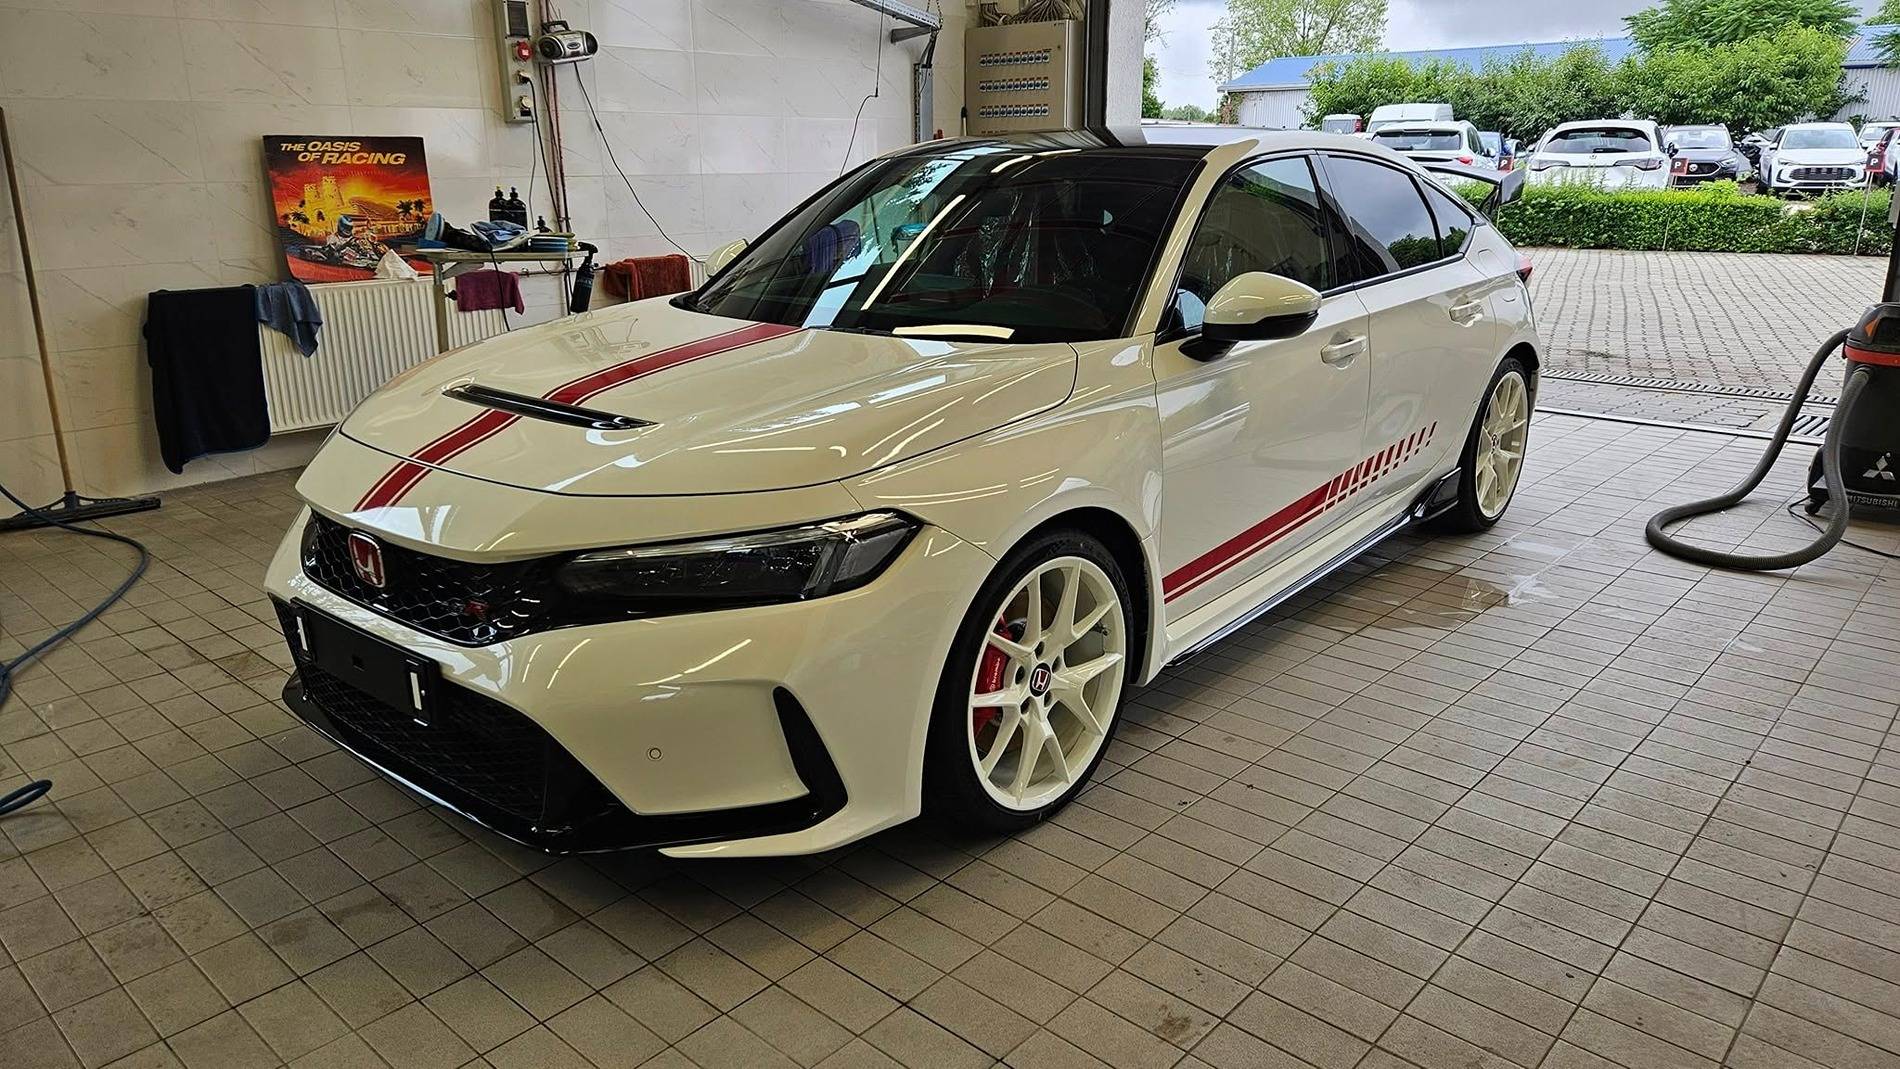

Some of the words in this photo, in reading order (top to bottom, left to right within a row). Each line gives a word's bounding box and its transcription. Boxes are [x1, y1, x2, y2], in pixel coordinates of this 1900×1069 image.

[280, 143, 306, 151] THE
[307, 141, 361, 151] OASIS
[297, 152, 322, 162] OF
[321, 152, 406, 165] RACING
[1870, 158, 1879, 166] P
[1500, 159, 1508, 168] P
[1674, 161, 1681, 169] P
